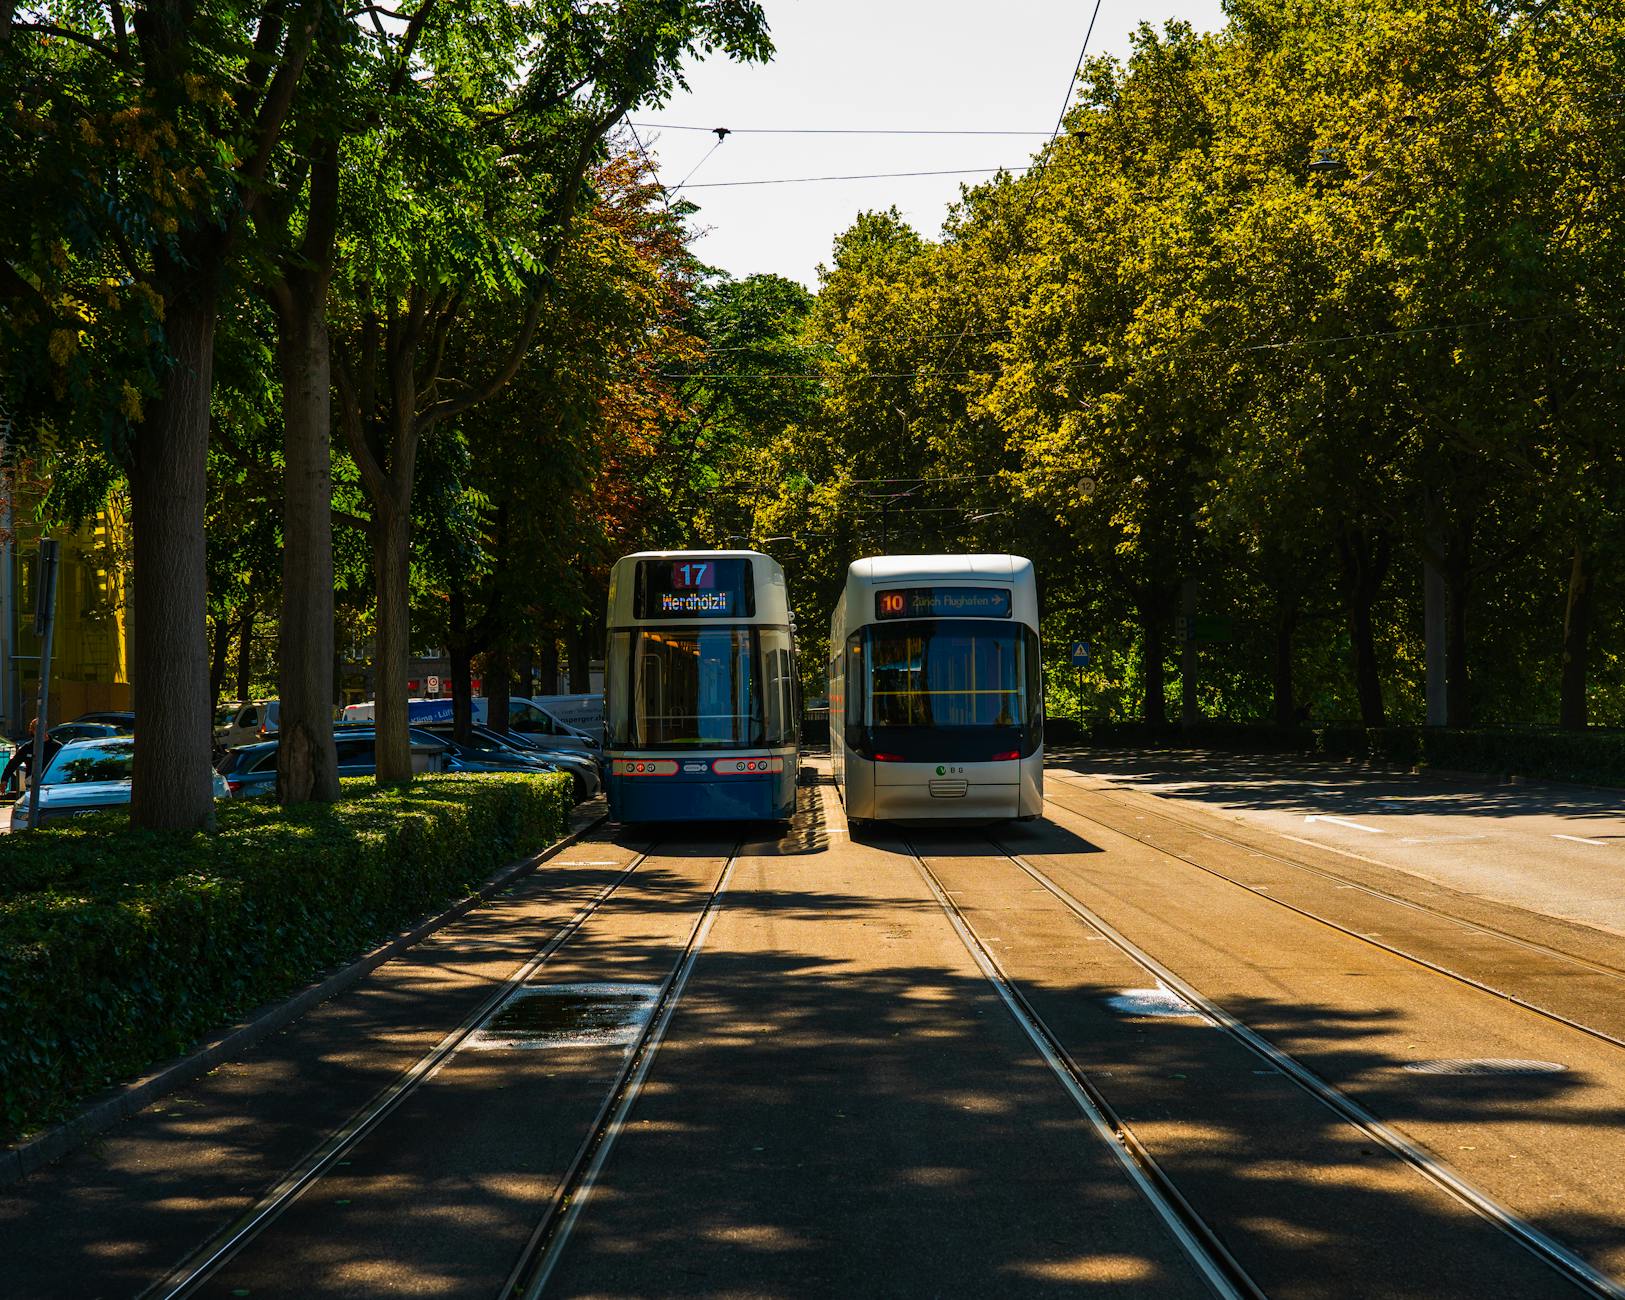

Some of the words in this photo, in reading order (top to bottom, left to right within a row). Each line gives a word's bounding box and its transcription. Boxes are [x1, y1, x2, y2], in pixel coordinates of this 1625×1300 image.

[1081, 482, 1092, 491] 12
[680, 564, 707, 586] 17
[662, 592, 726, 610] Werdhölzli
[883, 595, 903, 611] 10
[944, 595, 989, 608] Flughafen
